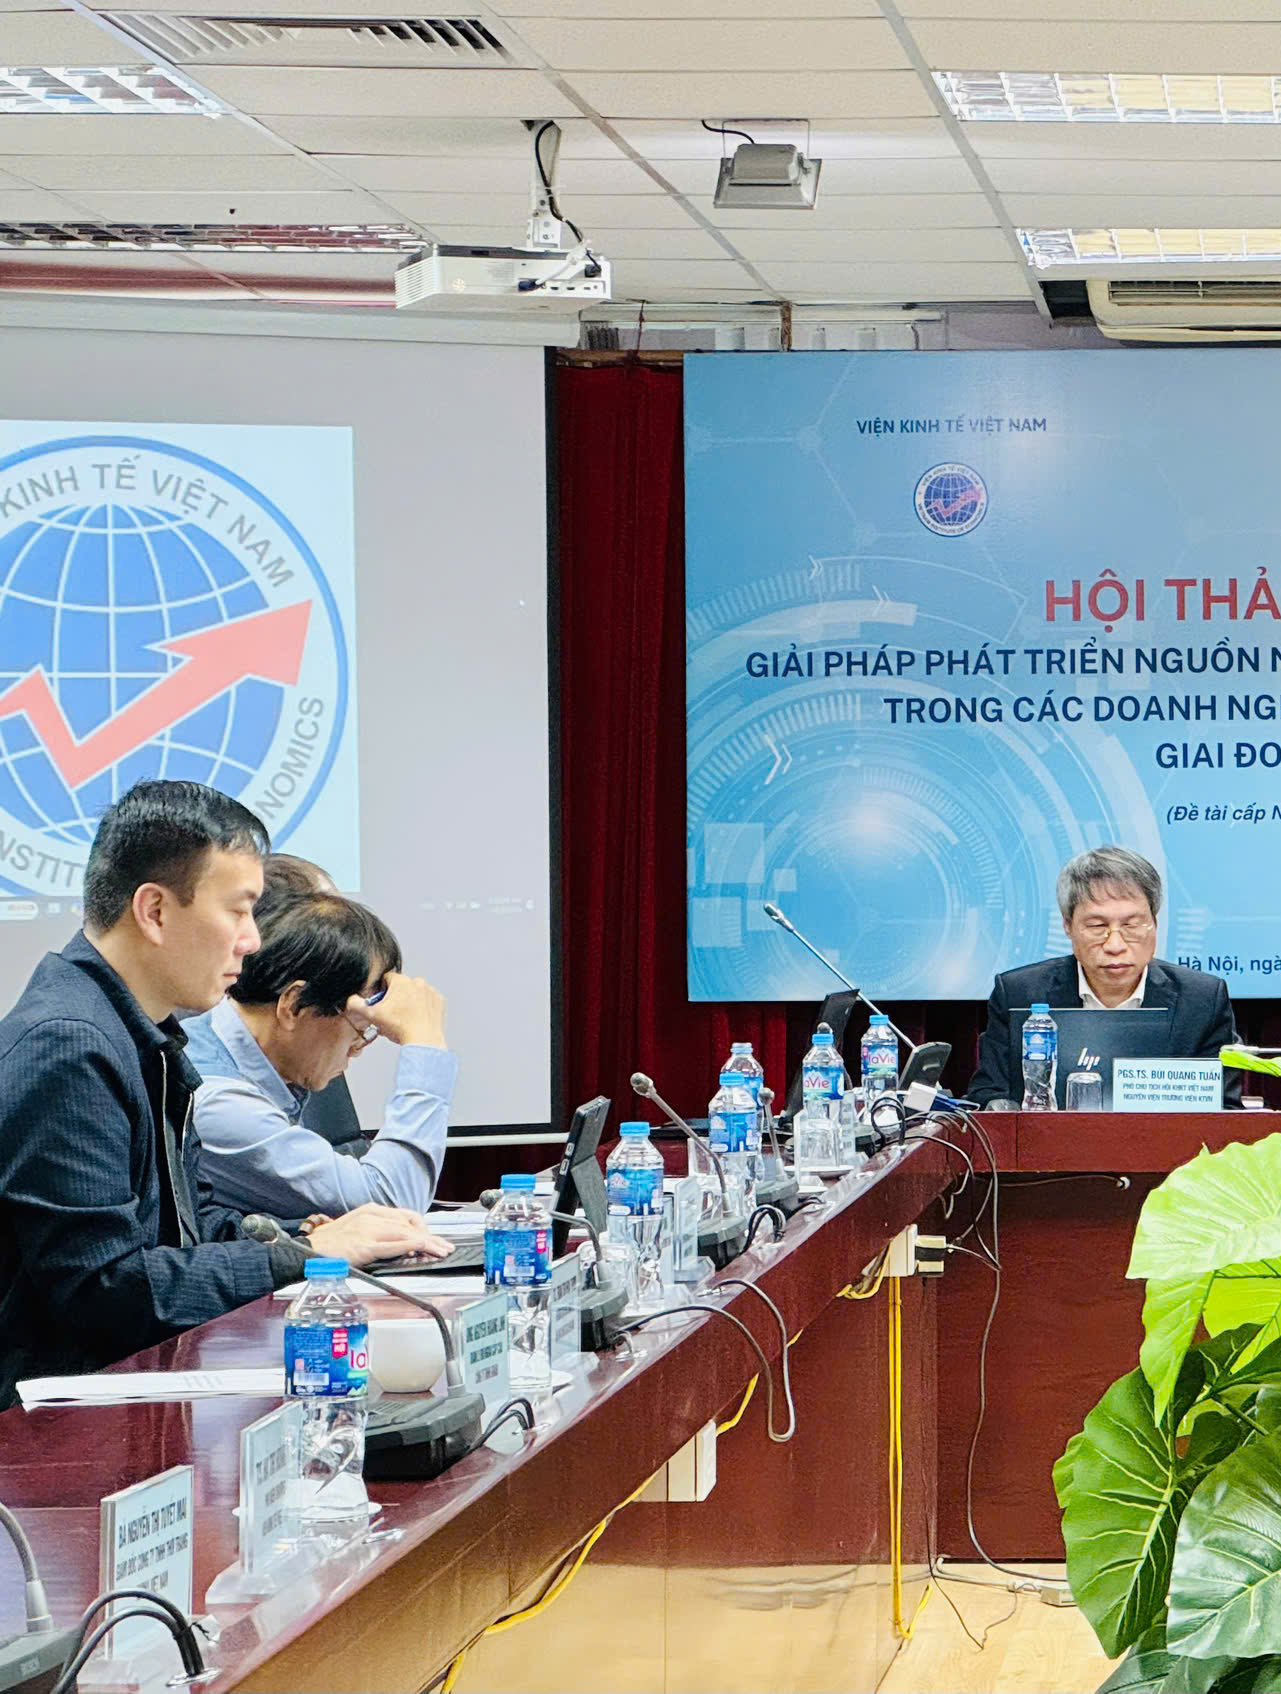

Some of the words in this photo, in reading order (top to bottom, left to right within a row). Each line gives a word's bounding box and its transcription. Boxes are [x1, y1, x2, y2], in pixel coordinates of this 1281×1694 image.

[856, 416, 895, 438] VIỆN
[899, 419, 940, 434] KINH
[944, 413, 965, 433] TẾ
[968, 415, 1004, 436] VIỆT
[1008, 417, 1047, 433] NAM
[0, 464, 81, 518] KINH
[91, 454, 142, 490] TẾ
[151, 467, 229, 520] VIỆT
[226, 513, 295, 589] NAM
[1045, 568, 1145, 633] HỘI
[745, 643, 813, 679] GIẢI
[824, 643, 916, 677] PHÁP
[925, 642, 1016, 676] PHÁT
[1023, 637, 1124, 675] TRIỂN
[1135, 637, 1260, 674] NGUỒN
[884, 696, 1003, 724] TRONG
[1013, 689, 1084, 723] CÁC
[1093, 694, 1217, 722] DOANH
[254, 697, 325, 820] NOMICS
[1155, 742, 1224, 769] GIAI
[1166, 803, 1199, 825] (Đề
[1204, 804, 1228, 821] tài
[1232, 801, 1266, 825] cấp
[1178, 957, 1202, 972] Hà
[1208, 956, 1244, 976] Nội,
[1077, 1047, 1101, 1071] hp
[1117, 1069, 1148, 1080] PGS.TS.
[1167, 1070, 1197, 1081] QUANG
